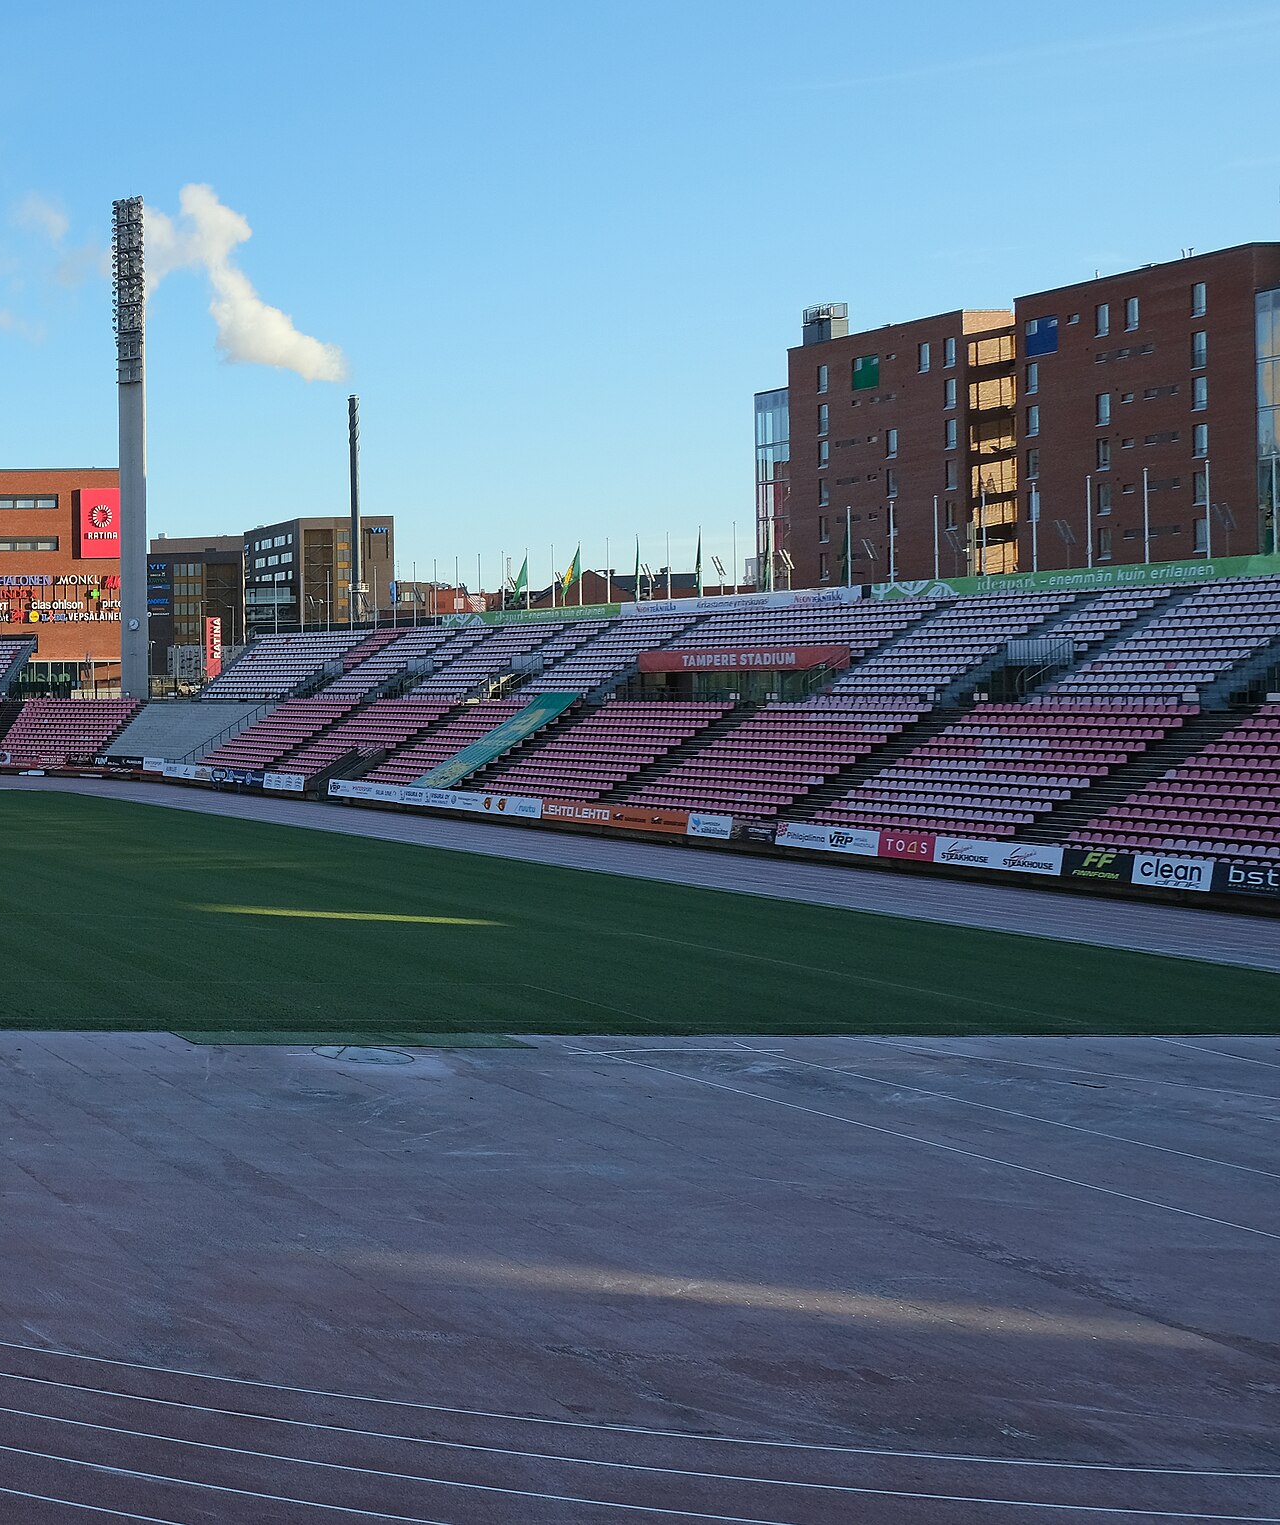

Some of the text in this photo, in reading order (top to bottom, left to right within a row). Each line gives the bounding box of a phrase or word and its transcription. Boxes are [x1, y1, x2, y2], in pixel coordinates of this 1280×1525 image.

[976, 574, 1036, 591] ideapark
[1049, 568, 1112, 586] enemmän
[1116, 564, 1145, 581] kuin
[1151, 563, 1215, 579] erilainen
[32, 600, 83, 610] clas ohlson
[68, 611, 121, 621] VEPSÄLÄINE
[213, 618, 221, 659] RATINA
[682, 653, 796, 667] TAMPERE STADIUM
[543, 804, 574, 817] LEHTO
[575, 807, 610, 821] LEHTO
[829, 834, 854, 845] VRP
[941, 852, 989, 864] STEAKHOUSE
[1002, 858, 1053, 871] STEAKHOUSE
[1082, 852, 1117, 868] FF
[1140, 858, 1202, 882] clean
[1228, 865, 1280, 887] bst
